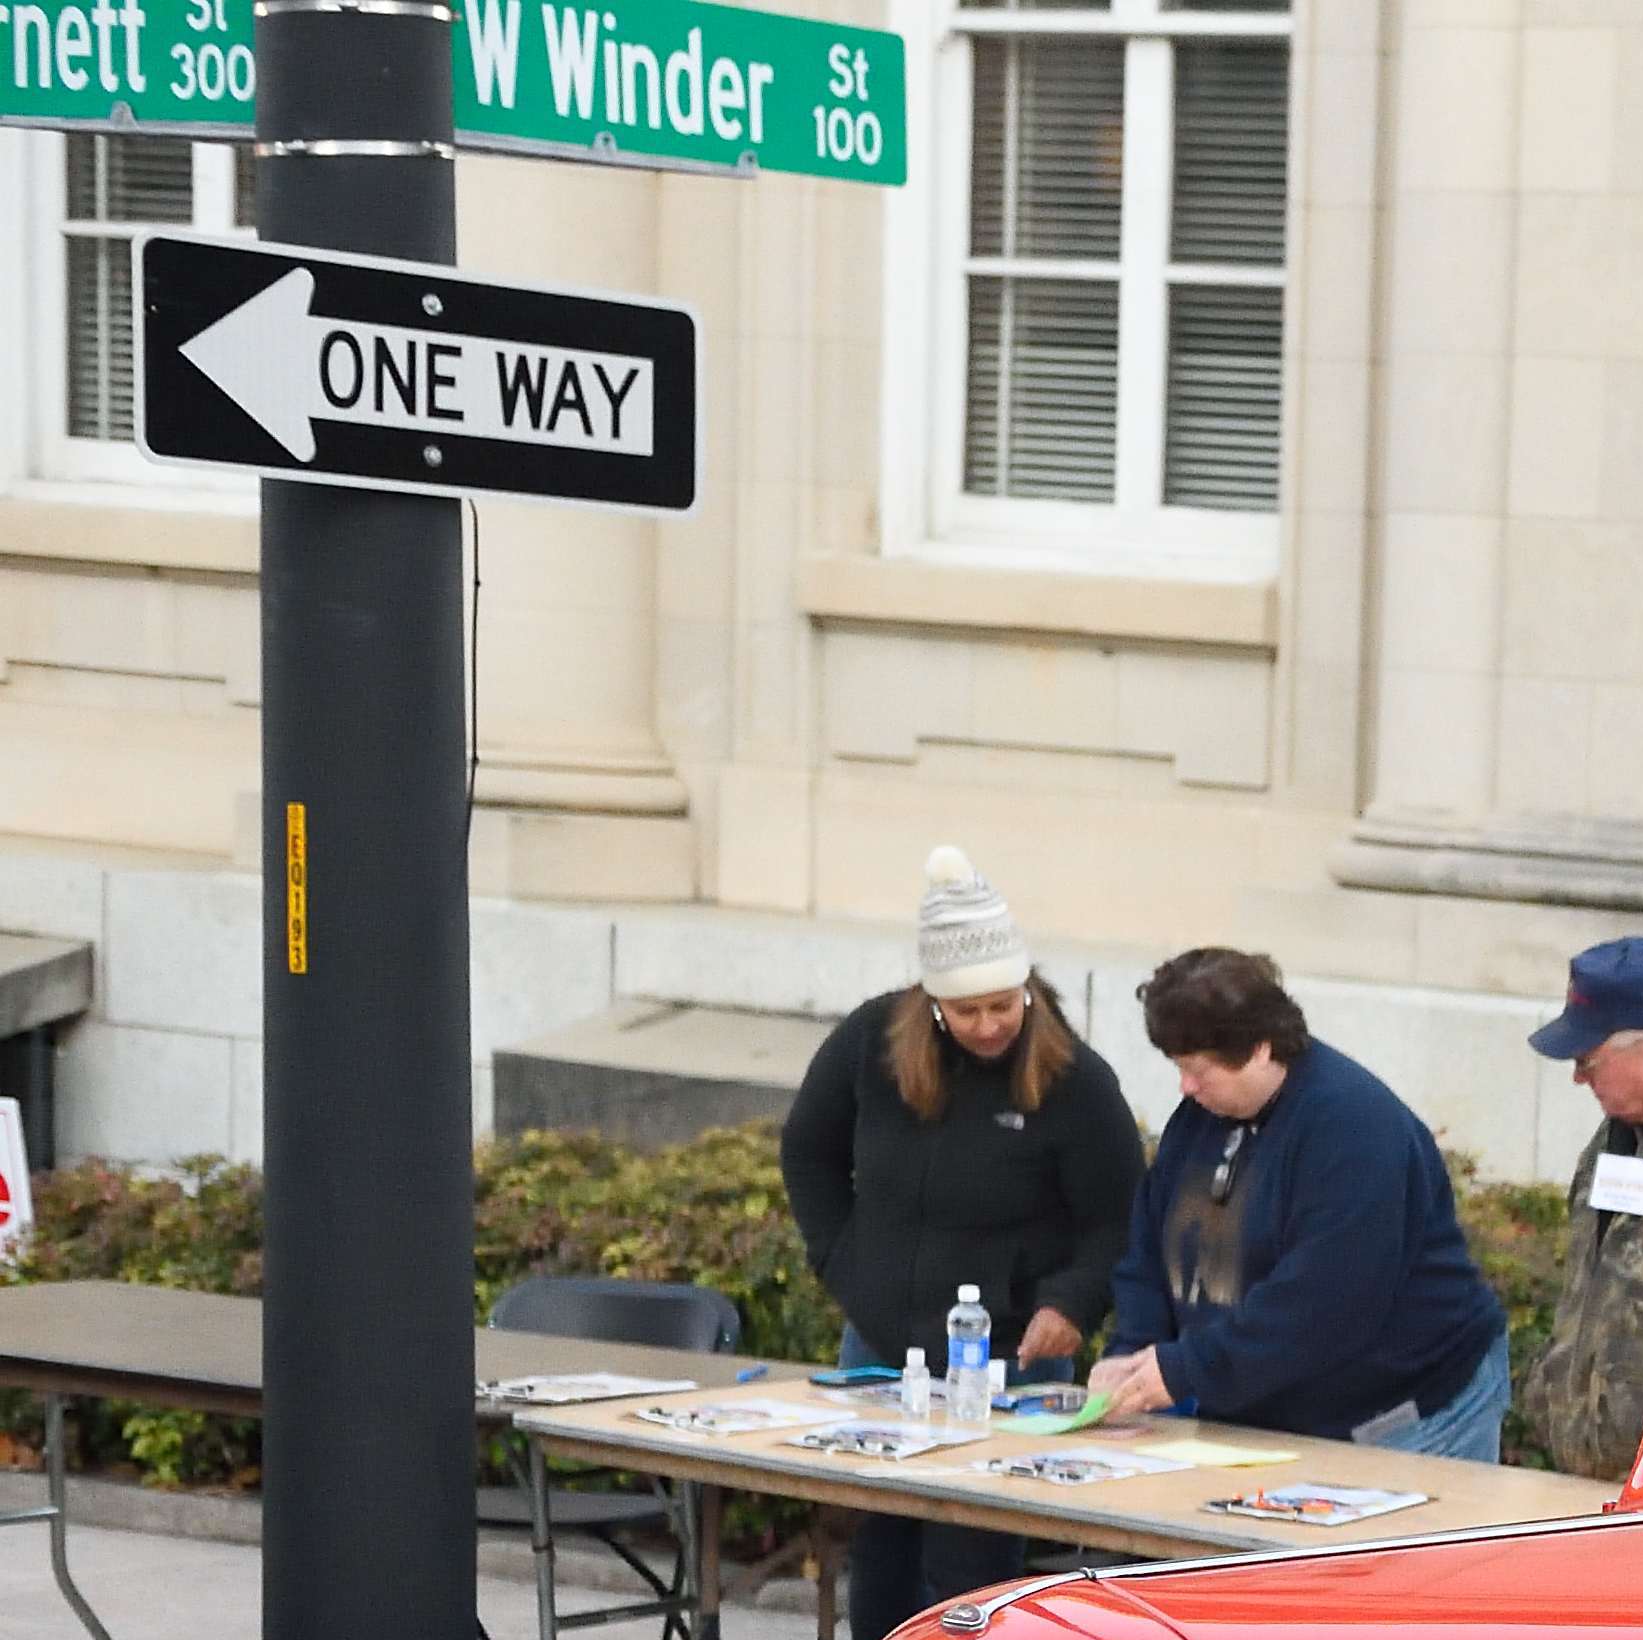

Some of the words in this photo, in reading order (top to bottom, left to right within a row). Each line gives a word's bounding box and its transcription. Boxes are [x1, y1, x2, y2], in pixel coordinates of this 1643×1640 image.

[170, 43, 256, 101] 300
[466, 0, 521, 109] W
[542, 2, 774, 144] Winder
[828, 43, 869, 101] St
[813, 104, 883, 165] 100
[319, 329, 464, 422] ONE
[496, 350, 640, 441] WAY
